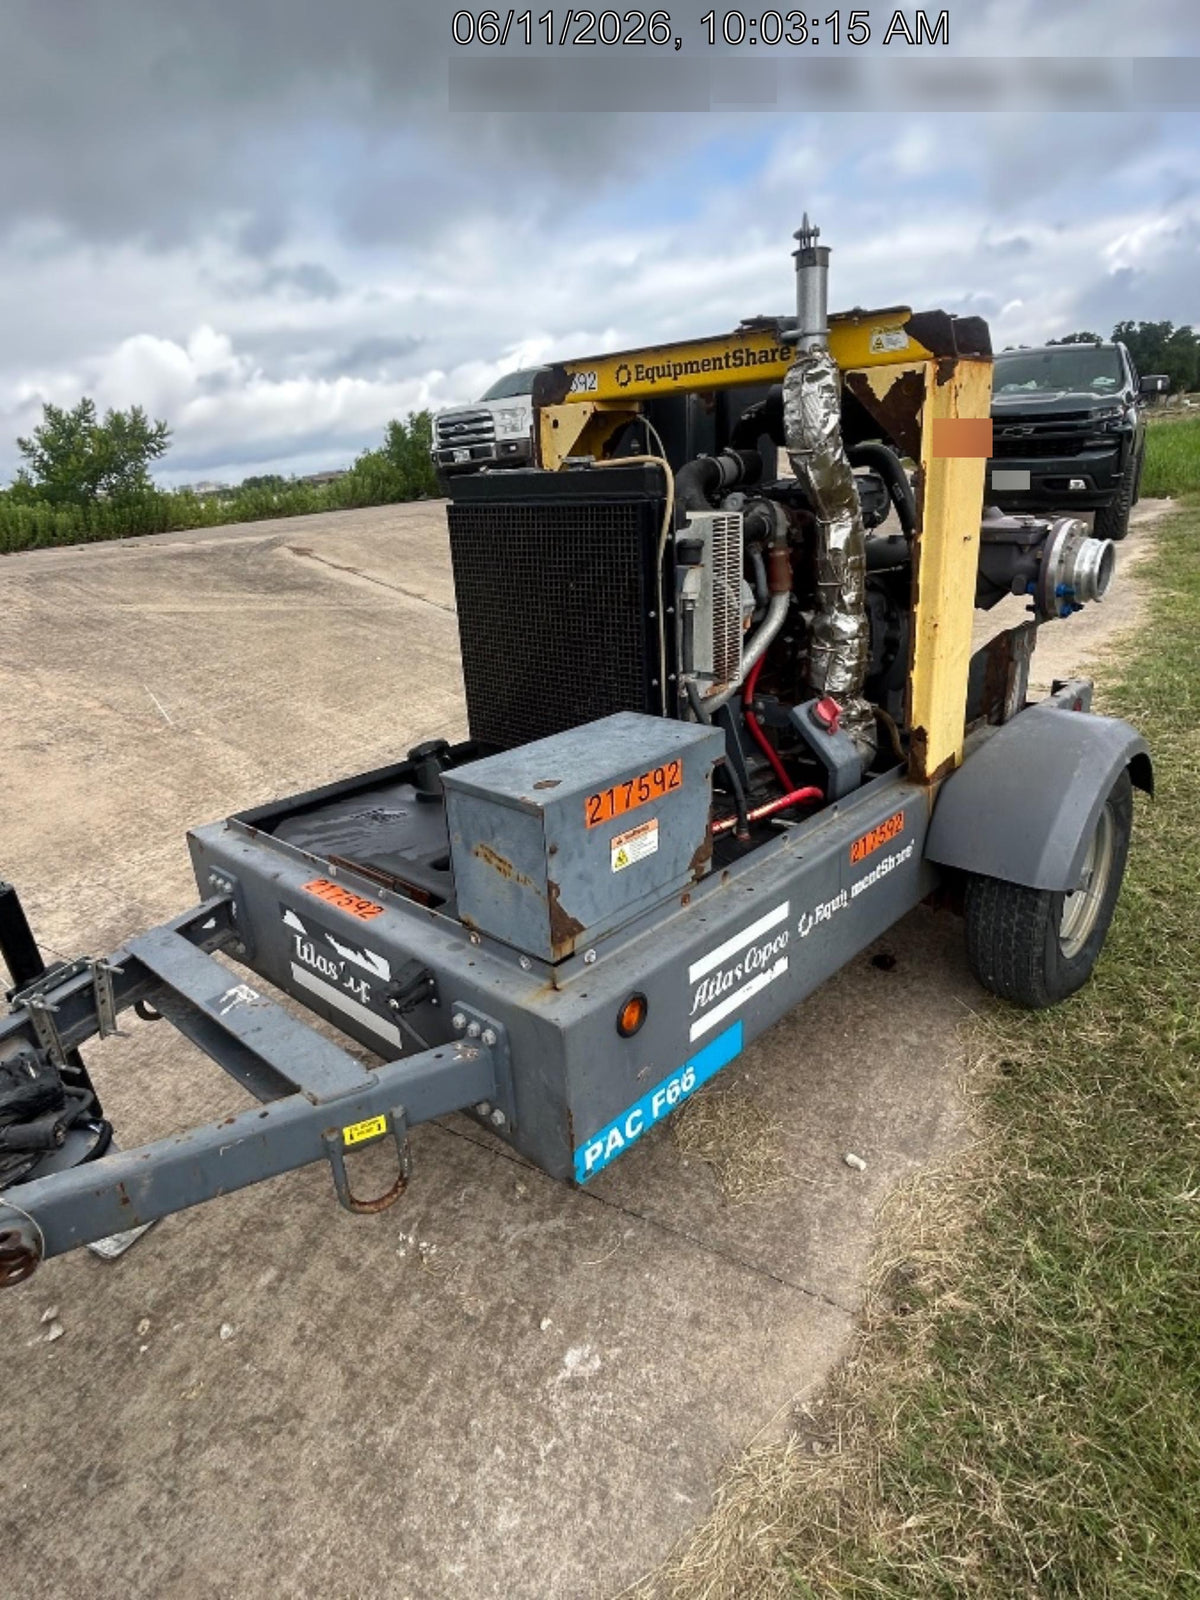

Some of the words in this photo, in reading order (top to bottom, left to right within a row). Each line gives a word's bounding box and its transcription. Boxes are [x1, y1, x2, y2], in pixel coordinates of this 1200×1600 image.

[634, 346, 791, 384] EquipmentShare
[588, 761, 681, 825] 217592
[851, 813, 903, 863] 217592
[305, 878, 385, 920] 217592
[689, 962, 744, 1016] Atlas
[744, 930, 789, 974] Copco
[584, 1108, 643, 1171] PAC
[652, 1066, 696, 1119] F66
